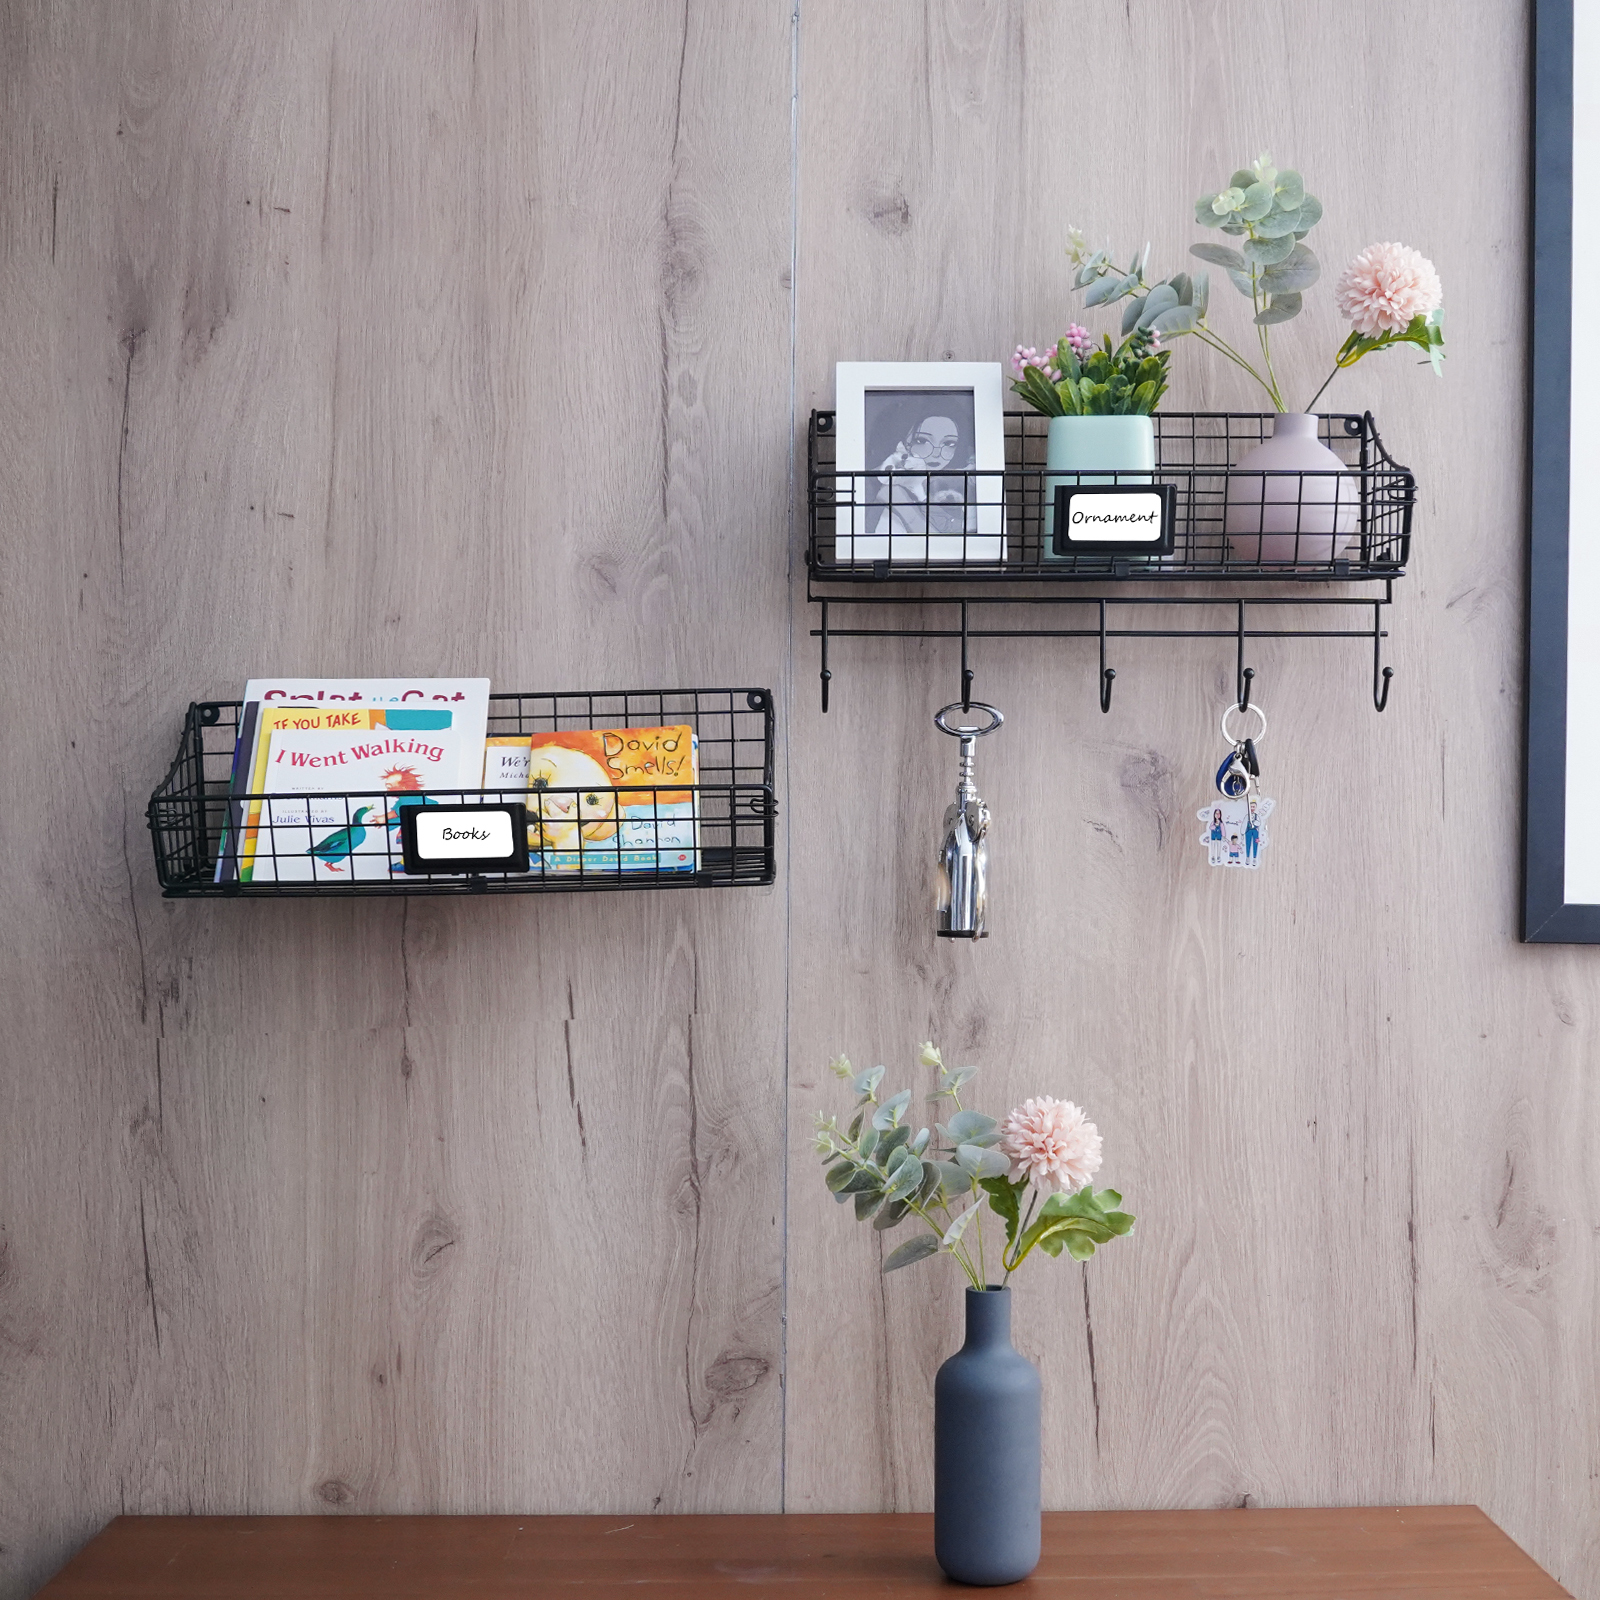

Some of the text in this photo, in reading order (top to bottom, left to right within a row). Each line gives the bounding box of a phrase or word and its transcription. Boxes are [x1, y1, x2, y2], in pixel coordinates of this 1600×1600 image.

[1071, 510, 1159, 525] Ornament
[292, 715, 320, 730] YOU
[325, 712, 362, 729] TAKE
[275, 738, 445, 768] I Went Walking
[602, 731, 683, 758] David
[606, 754, 687, 780] Smells!
[272, 815, 335, 824] Julie Vivas
[442, 826, 491, 841] Books
